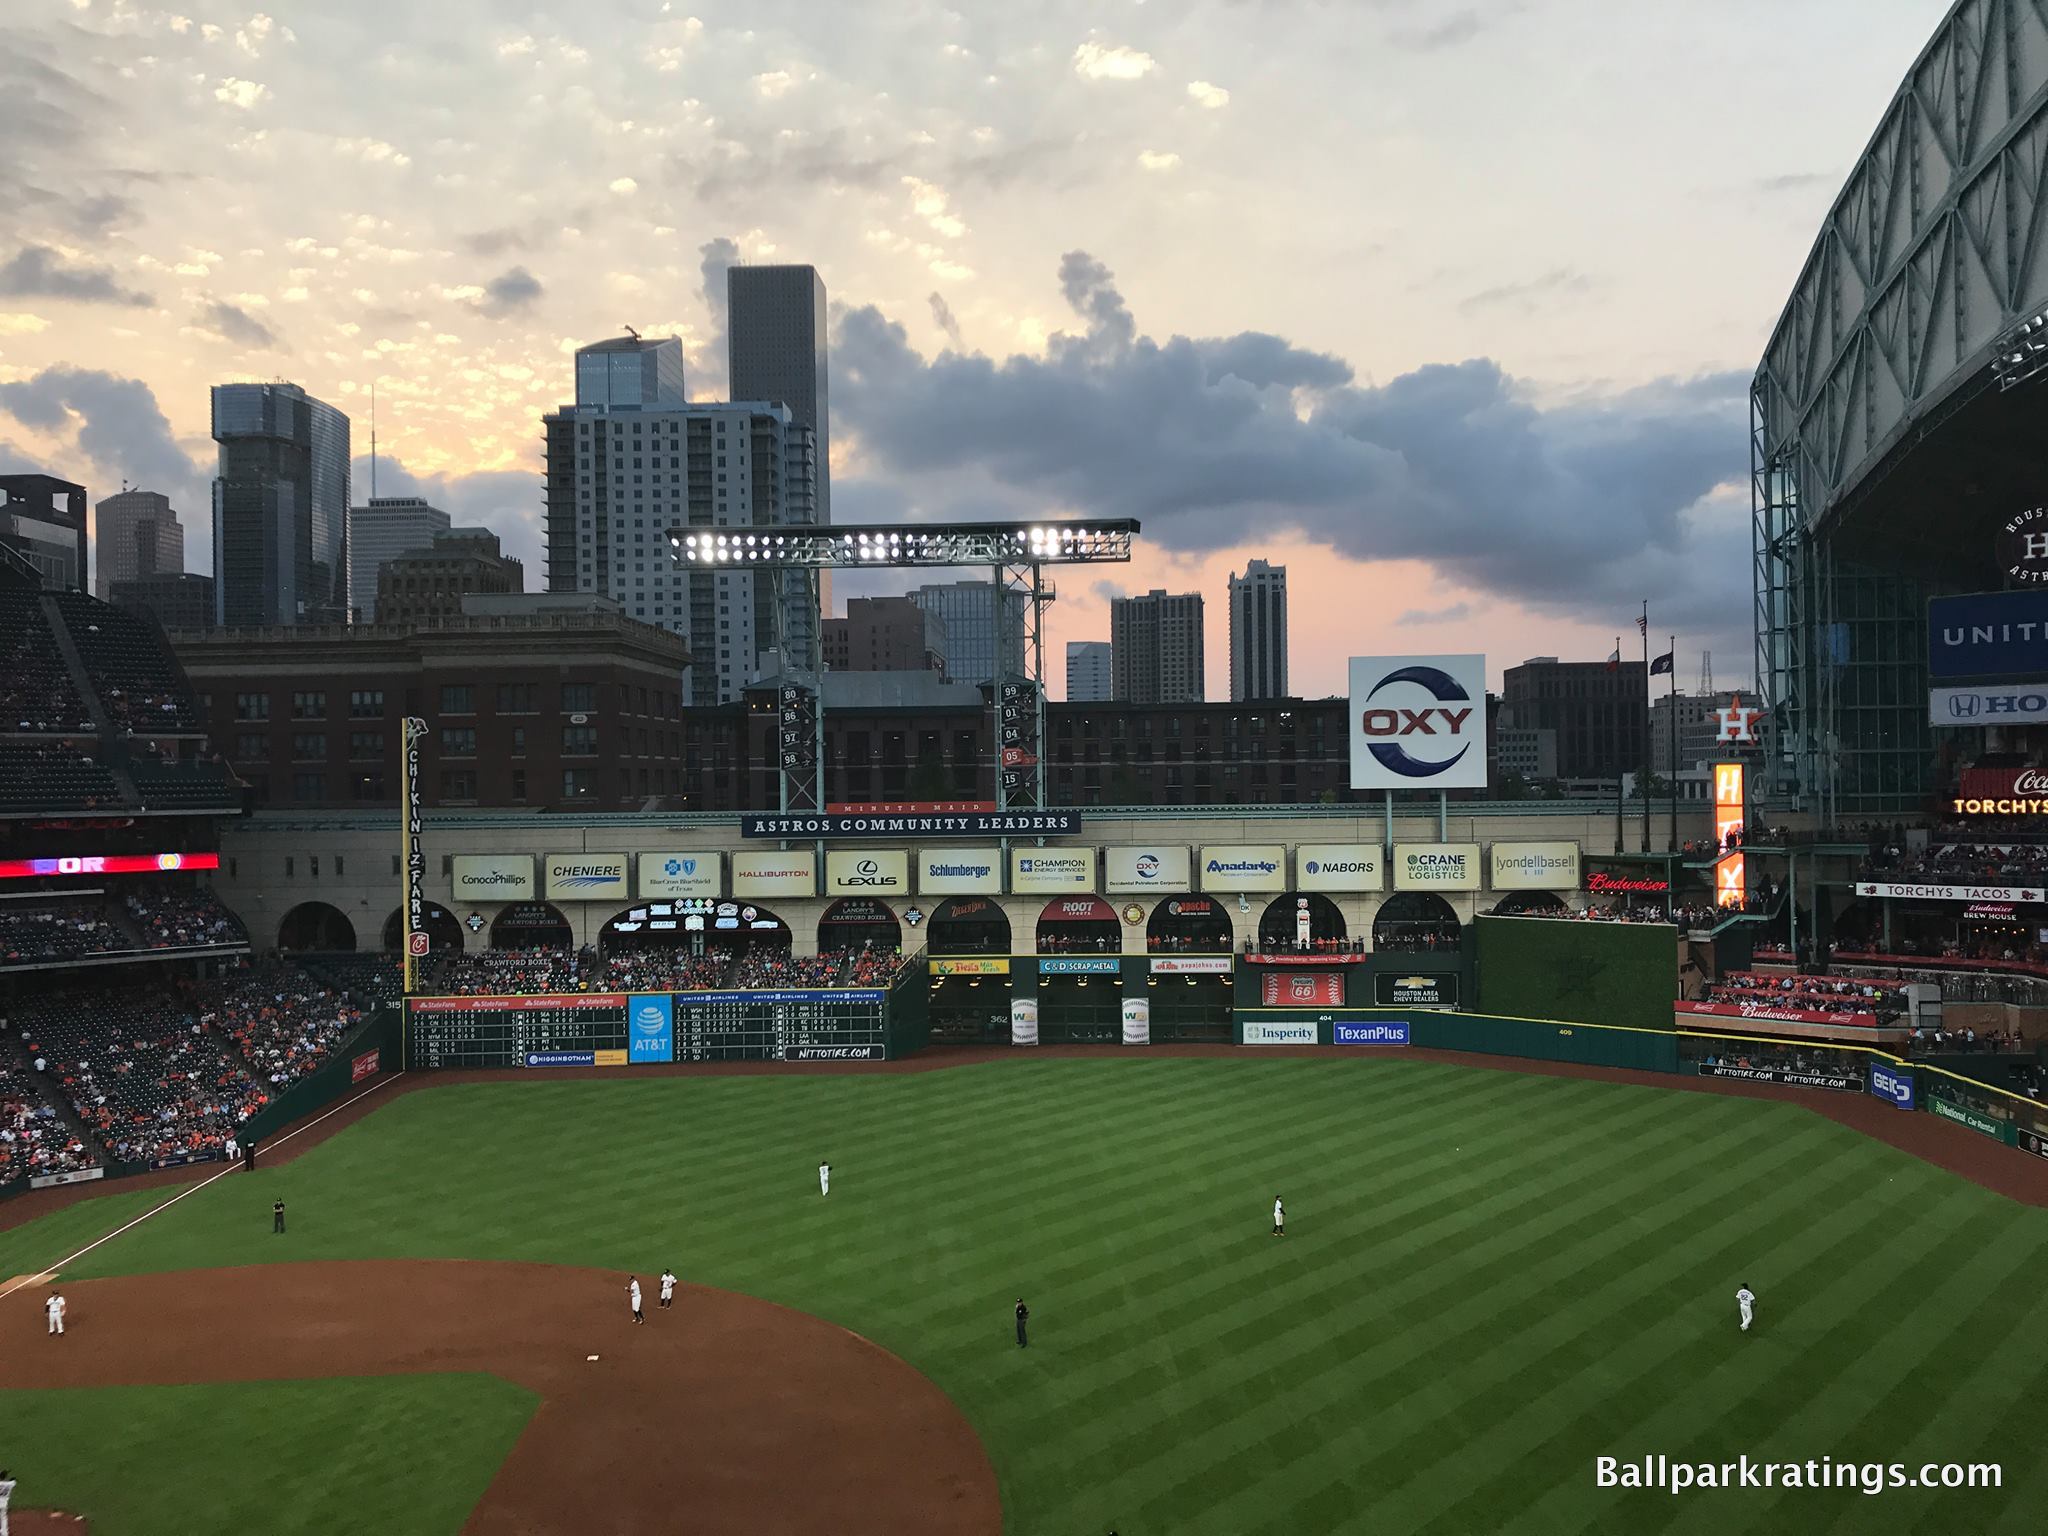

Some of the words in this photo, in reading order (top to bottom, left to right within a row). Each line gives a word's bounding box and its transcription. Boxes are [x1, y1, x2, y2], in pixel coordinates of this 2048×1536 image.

[2006, 507, 2048, 533] HOUS
[1943, 622, 2048, 646] UNIT
[784, 689, 796, 700] 80
[1004, 686, 1017, 697] 99
[784, 711, 796, 721] 86
[1005, 708, 1017, 718] 01
[1363, 708, 1473, 736] OXY
[1716, 708, 1758, 741] H
[784, 733, 796, 743] 97
[1005, 729, 1018, 739] 04
[784, 754, 796, 764] 98
[1006, 751, 1018, 761] 05
[1005, 774, 1016, 785] 15
[409, 750, 422, 834] CHIKIN
[754, 820, 830, 833] ASTROS
[840, 818, 971, 832] COMMUNITY
[978, 816, 1069, 829] LEADERS
[410, 837, 421, 865] IZ
[1034, 859, 1085, 867] CHAMPION
[1419, 855, 1466, 865] CRANE
[1496, 855, 1575, 871] lyondellbasell
[553, 866, 621, 876] CHENIERE
[930, 864, 991, 878] Schlumberger
[1206, 859, 1276, 873] Anadarko
[1322, 862, 1374, 873] NABORS
[738, 870, 809, 878] HALLIBURTON
[462, 874, 526, 886] ConocoPhillips
[838, 877, 897, 886] LEXUS
[1587, 873, 1669, 891] Budweiser
[1887, 885, 1953, 897] TORCHYS
[1964, 888, 2011, 899] TACOS
[411, 869, 422, 930] FARE
[1062, 902, 1094, 912] ROOT
[1967, 903, 2013, 913] Budweiser
[1963, 912, 1987, 920] BREW
[1988, 913, 2017, 921] HOUSE
[1044, 962, 1051, 971] C
[1052, 962, 1059, 971] &
[1059, 962, 1066, 971] D
[1069, 962, 1091, 971] SCRAP
[1092, 961, 1114, 970] METAL
[1295, 986, 1311, 996] 66
[385, 1001, 401, 1009] 315
[1739, 1004, 1802, 1021] Budweiser
[990, 1015, 1008, 1023] 362
[1262, 1027, 1314, 1040] Insperity
[1337, 1026, 1404, 1040] TexanPlus
[634, 1038, 668, 1051] AT&T
[799, 1047, 871, 1059] NITTOTIRE.COM
[1713, 1066, 1773, 1081] NITTOTIRE.COM
[1783, 1073, 1847, 1088] NITTOTIRE.COM
[1942, 1105, 1966, 1123] National
[1967, 1116, 1977, 1126] Car
[1977, 1120, 1996, 1134] Rental
